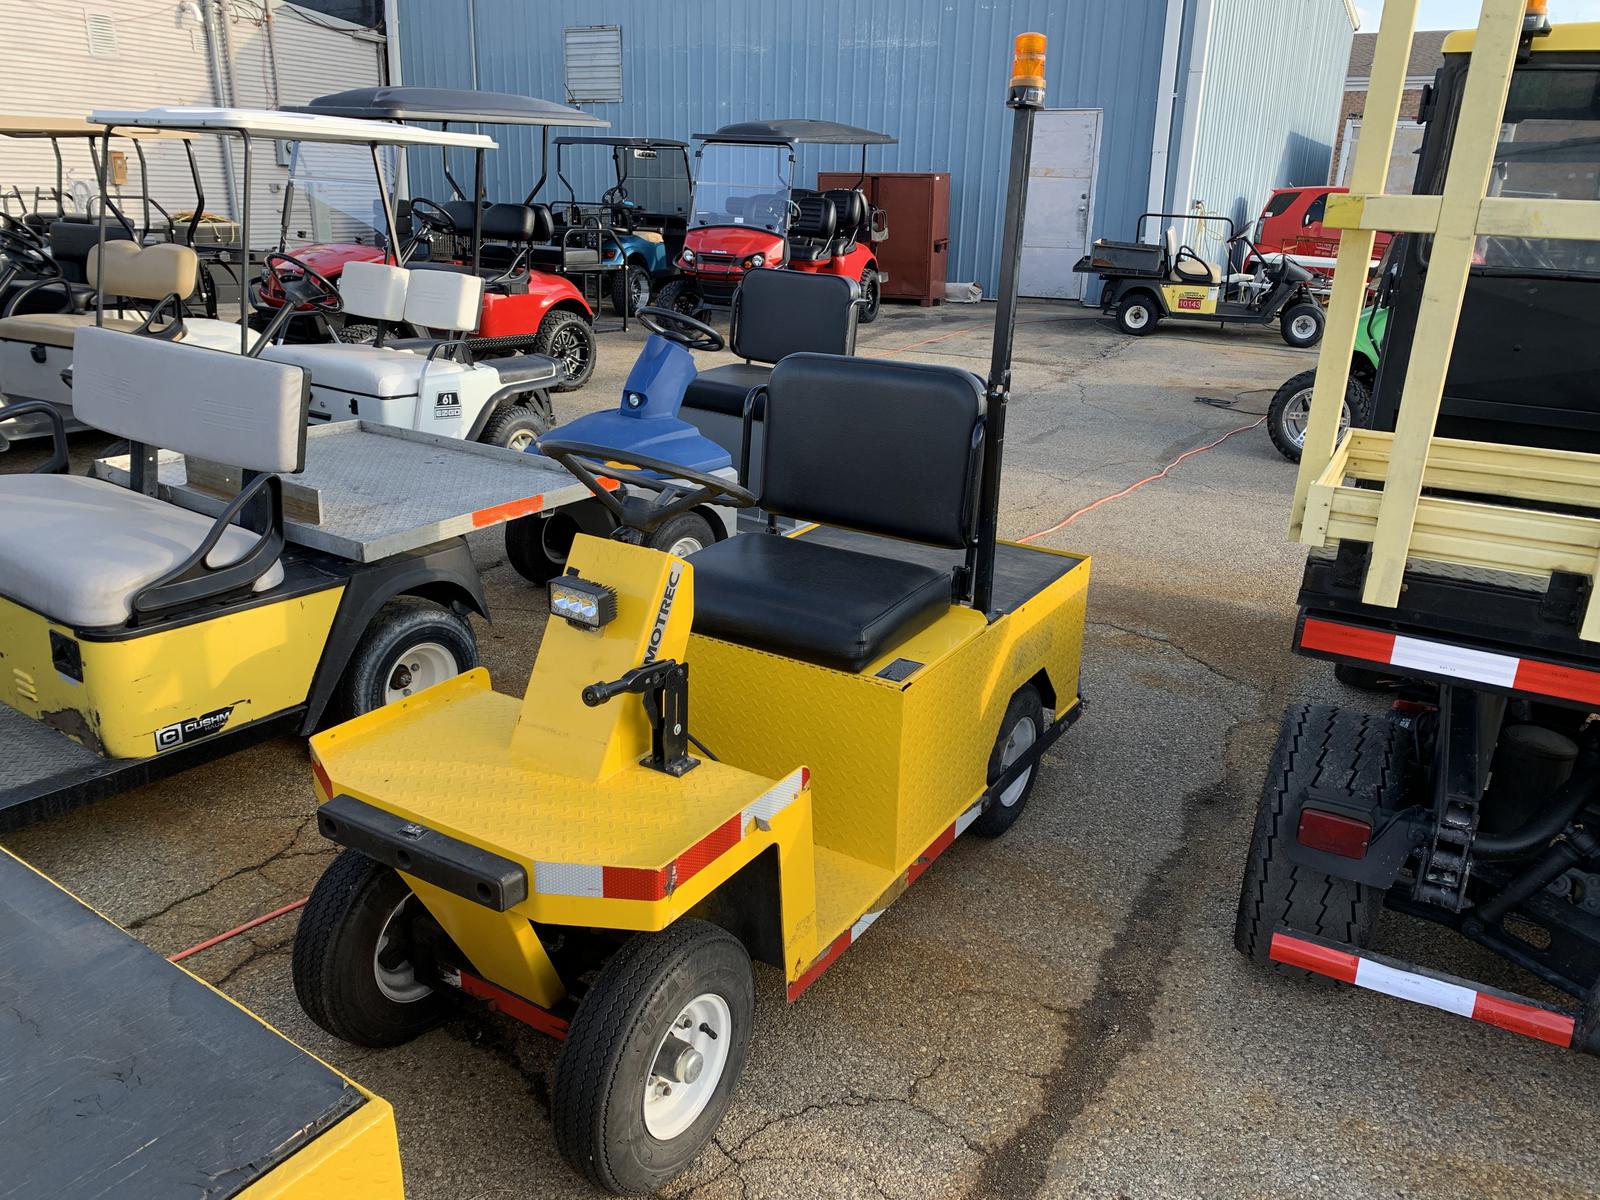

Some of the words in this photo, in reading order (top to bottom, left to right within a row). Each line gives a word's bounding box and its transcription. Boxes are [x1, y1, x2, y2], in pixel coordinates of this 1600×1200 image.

[1180, 300, 1201, 309] 10143
[442, 394, 453, 405] 61
[643, 571, 680, 665] MOTREC
